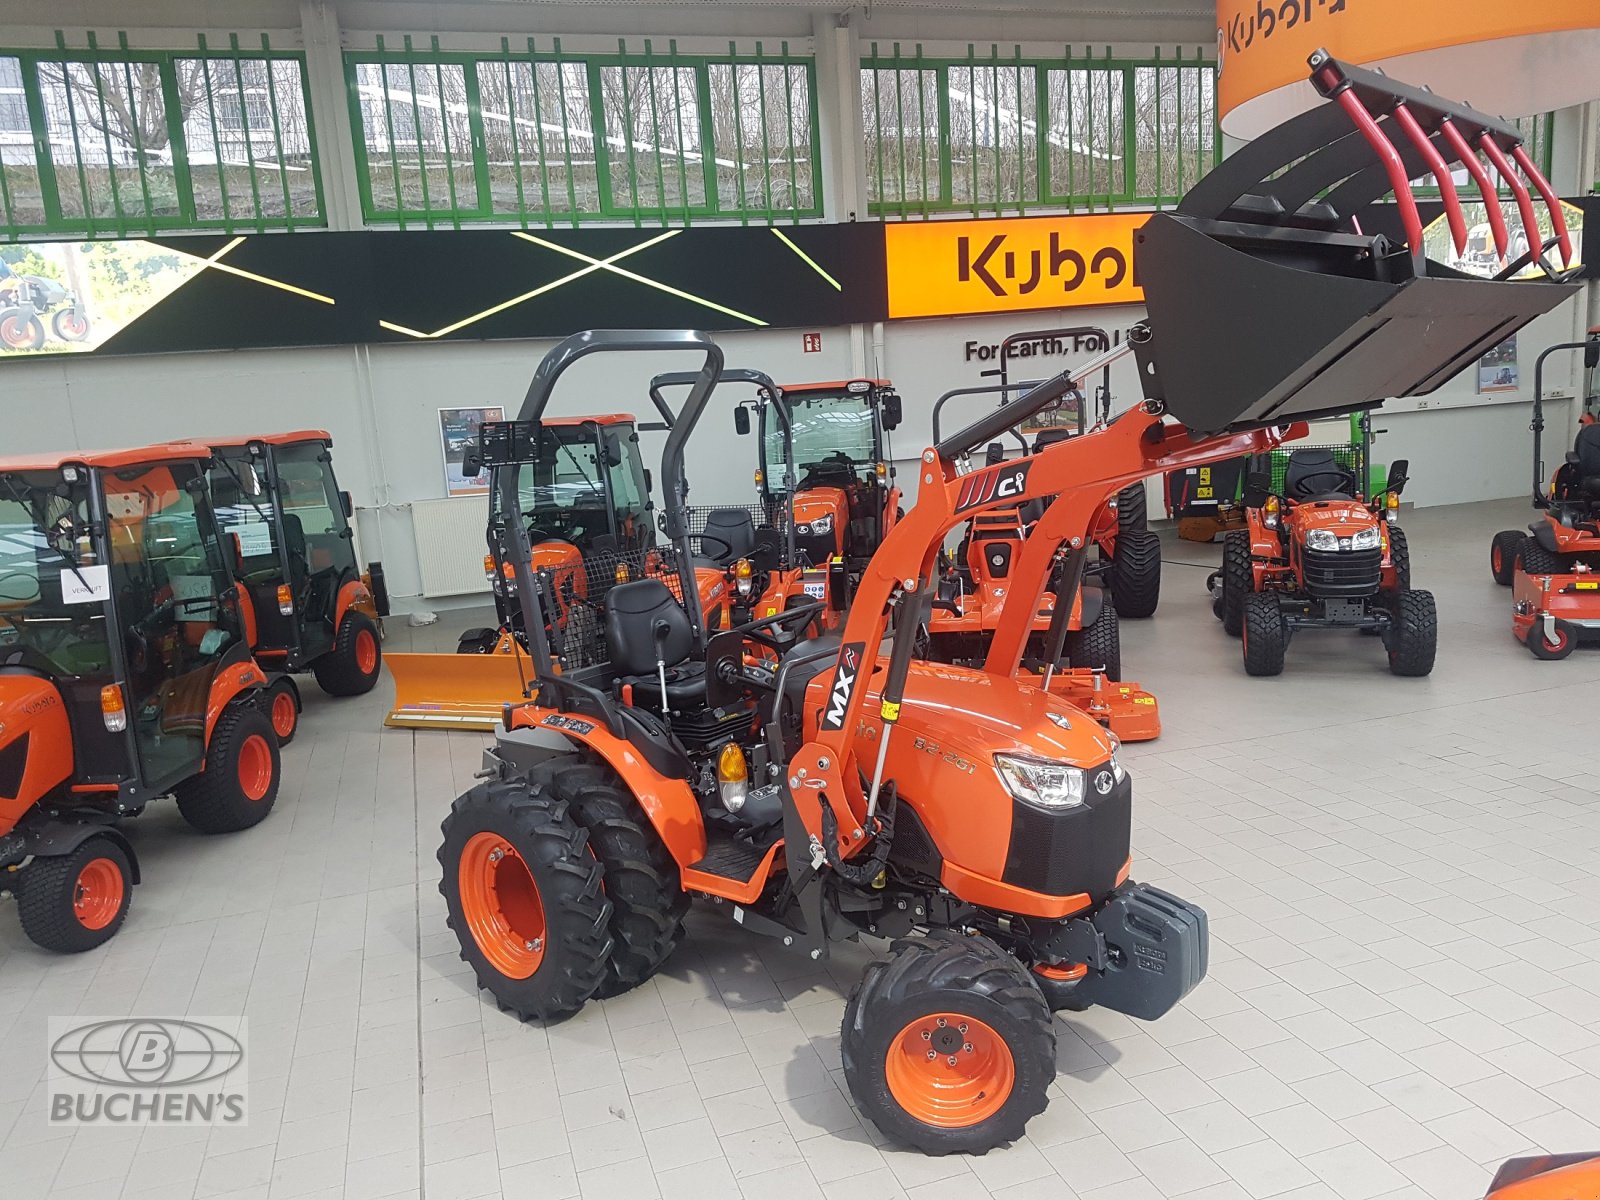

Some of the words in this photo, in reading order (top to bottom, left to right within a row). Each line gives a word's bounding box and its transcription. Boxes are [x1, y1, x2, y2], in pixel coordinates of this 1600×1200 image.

[958, 231, 1144, 297] Kubo
[965, 341, 999, 361] For
[1006, 335, 1069, 358] Earth,
[72, 585, 103, 594] VERKUFT
[827, 666, 855, 728] MX
